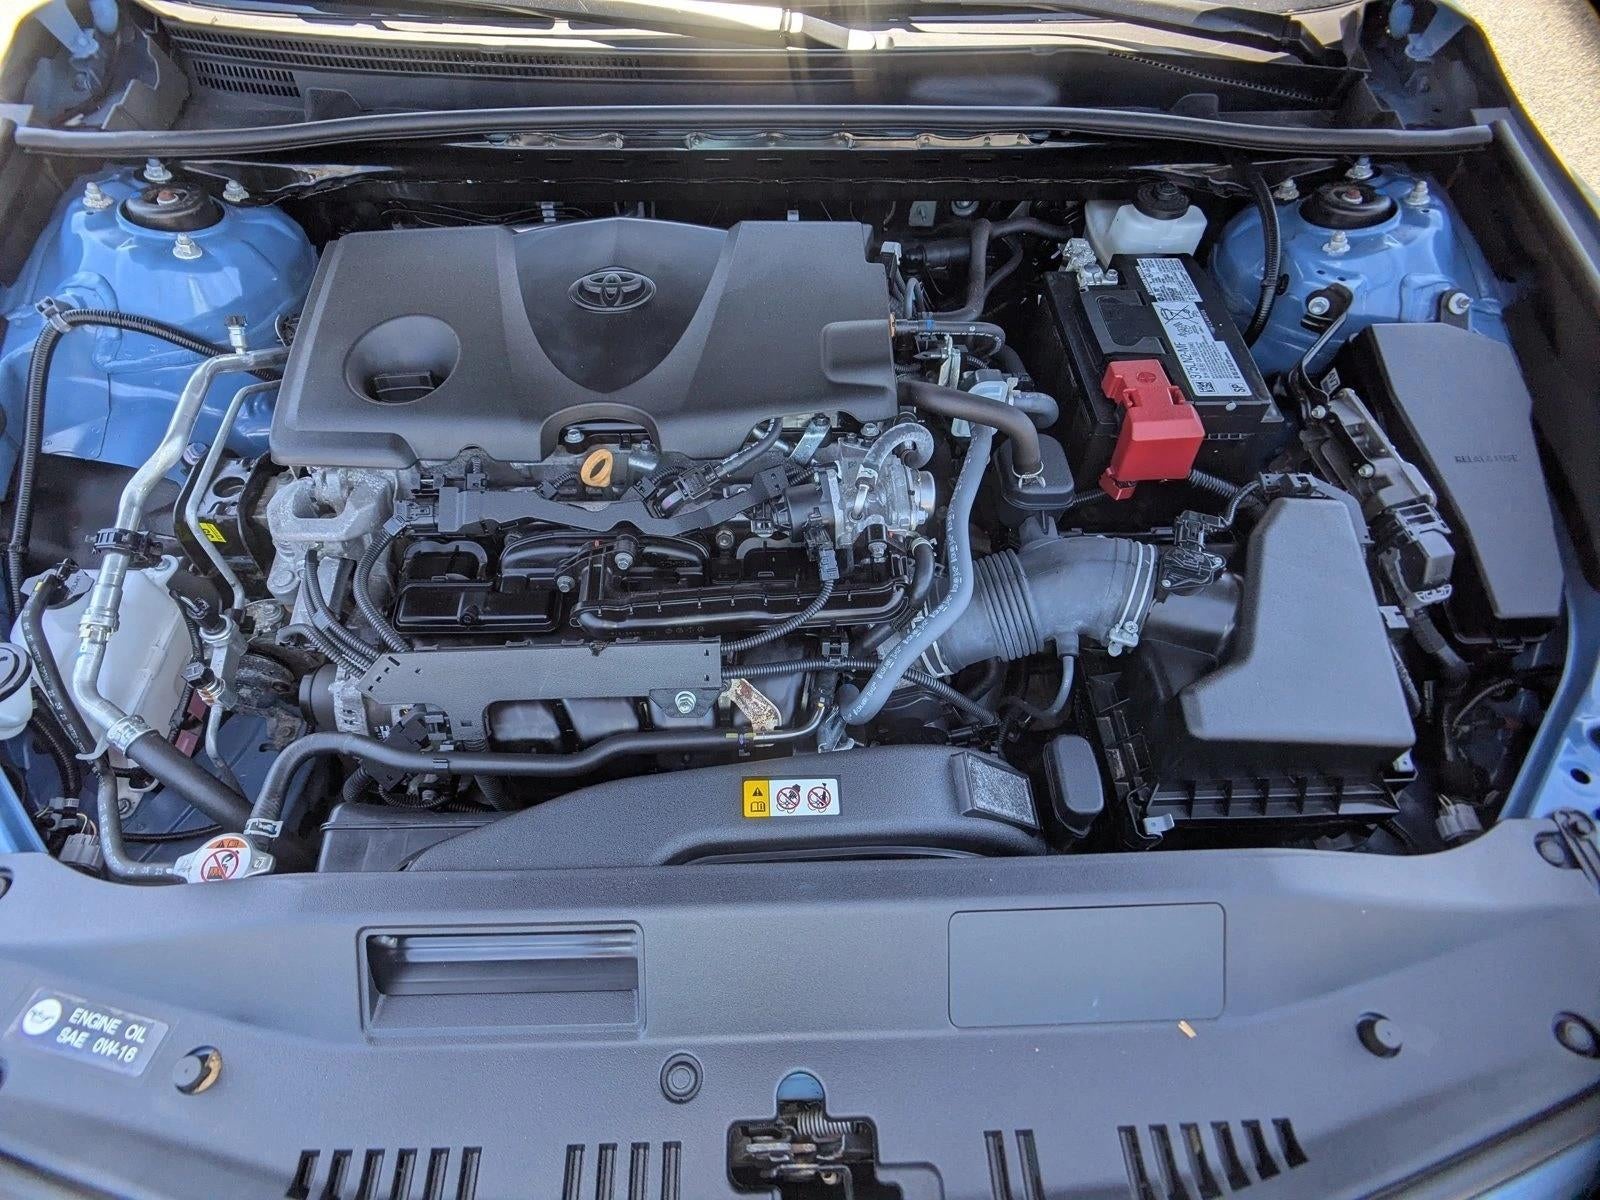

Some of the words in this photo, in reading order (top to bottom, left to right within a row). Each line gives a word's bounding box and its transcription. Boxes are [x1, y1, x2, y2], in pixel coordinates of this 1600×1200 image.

[68, 1007, 122, 1036] ENGINE
[124, 1023, 148, 1044] OIL
[55, 1026, 91, 1049] SAE
[92, 1037, 138, 1063] 0W-16
